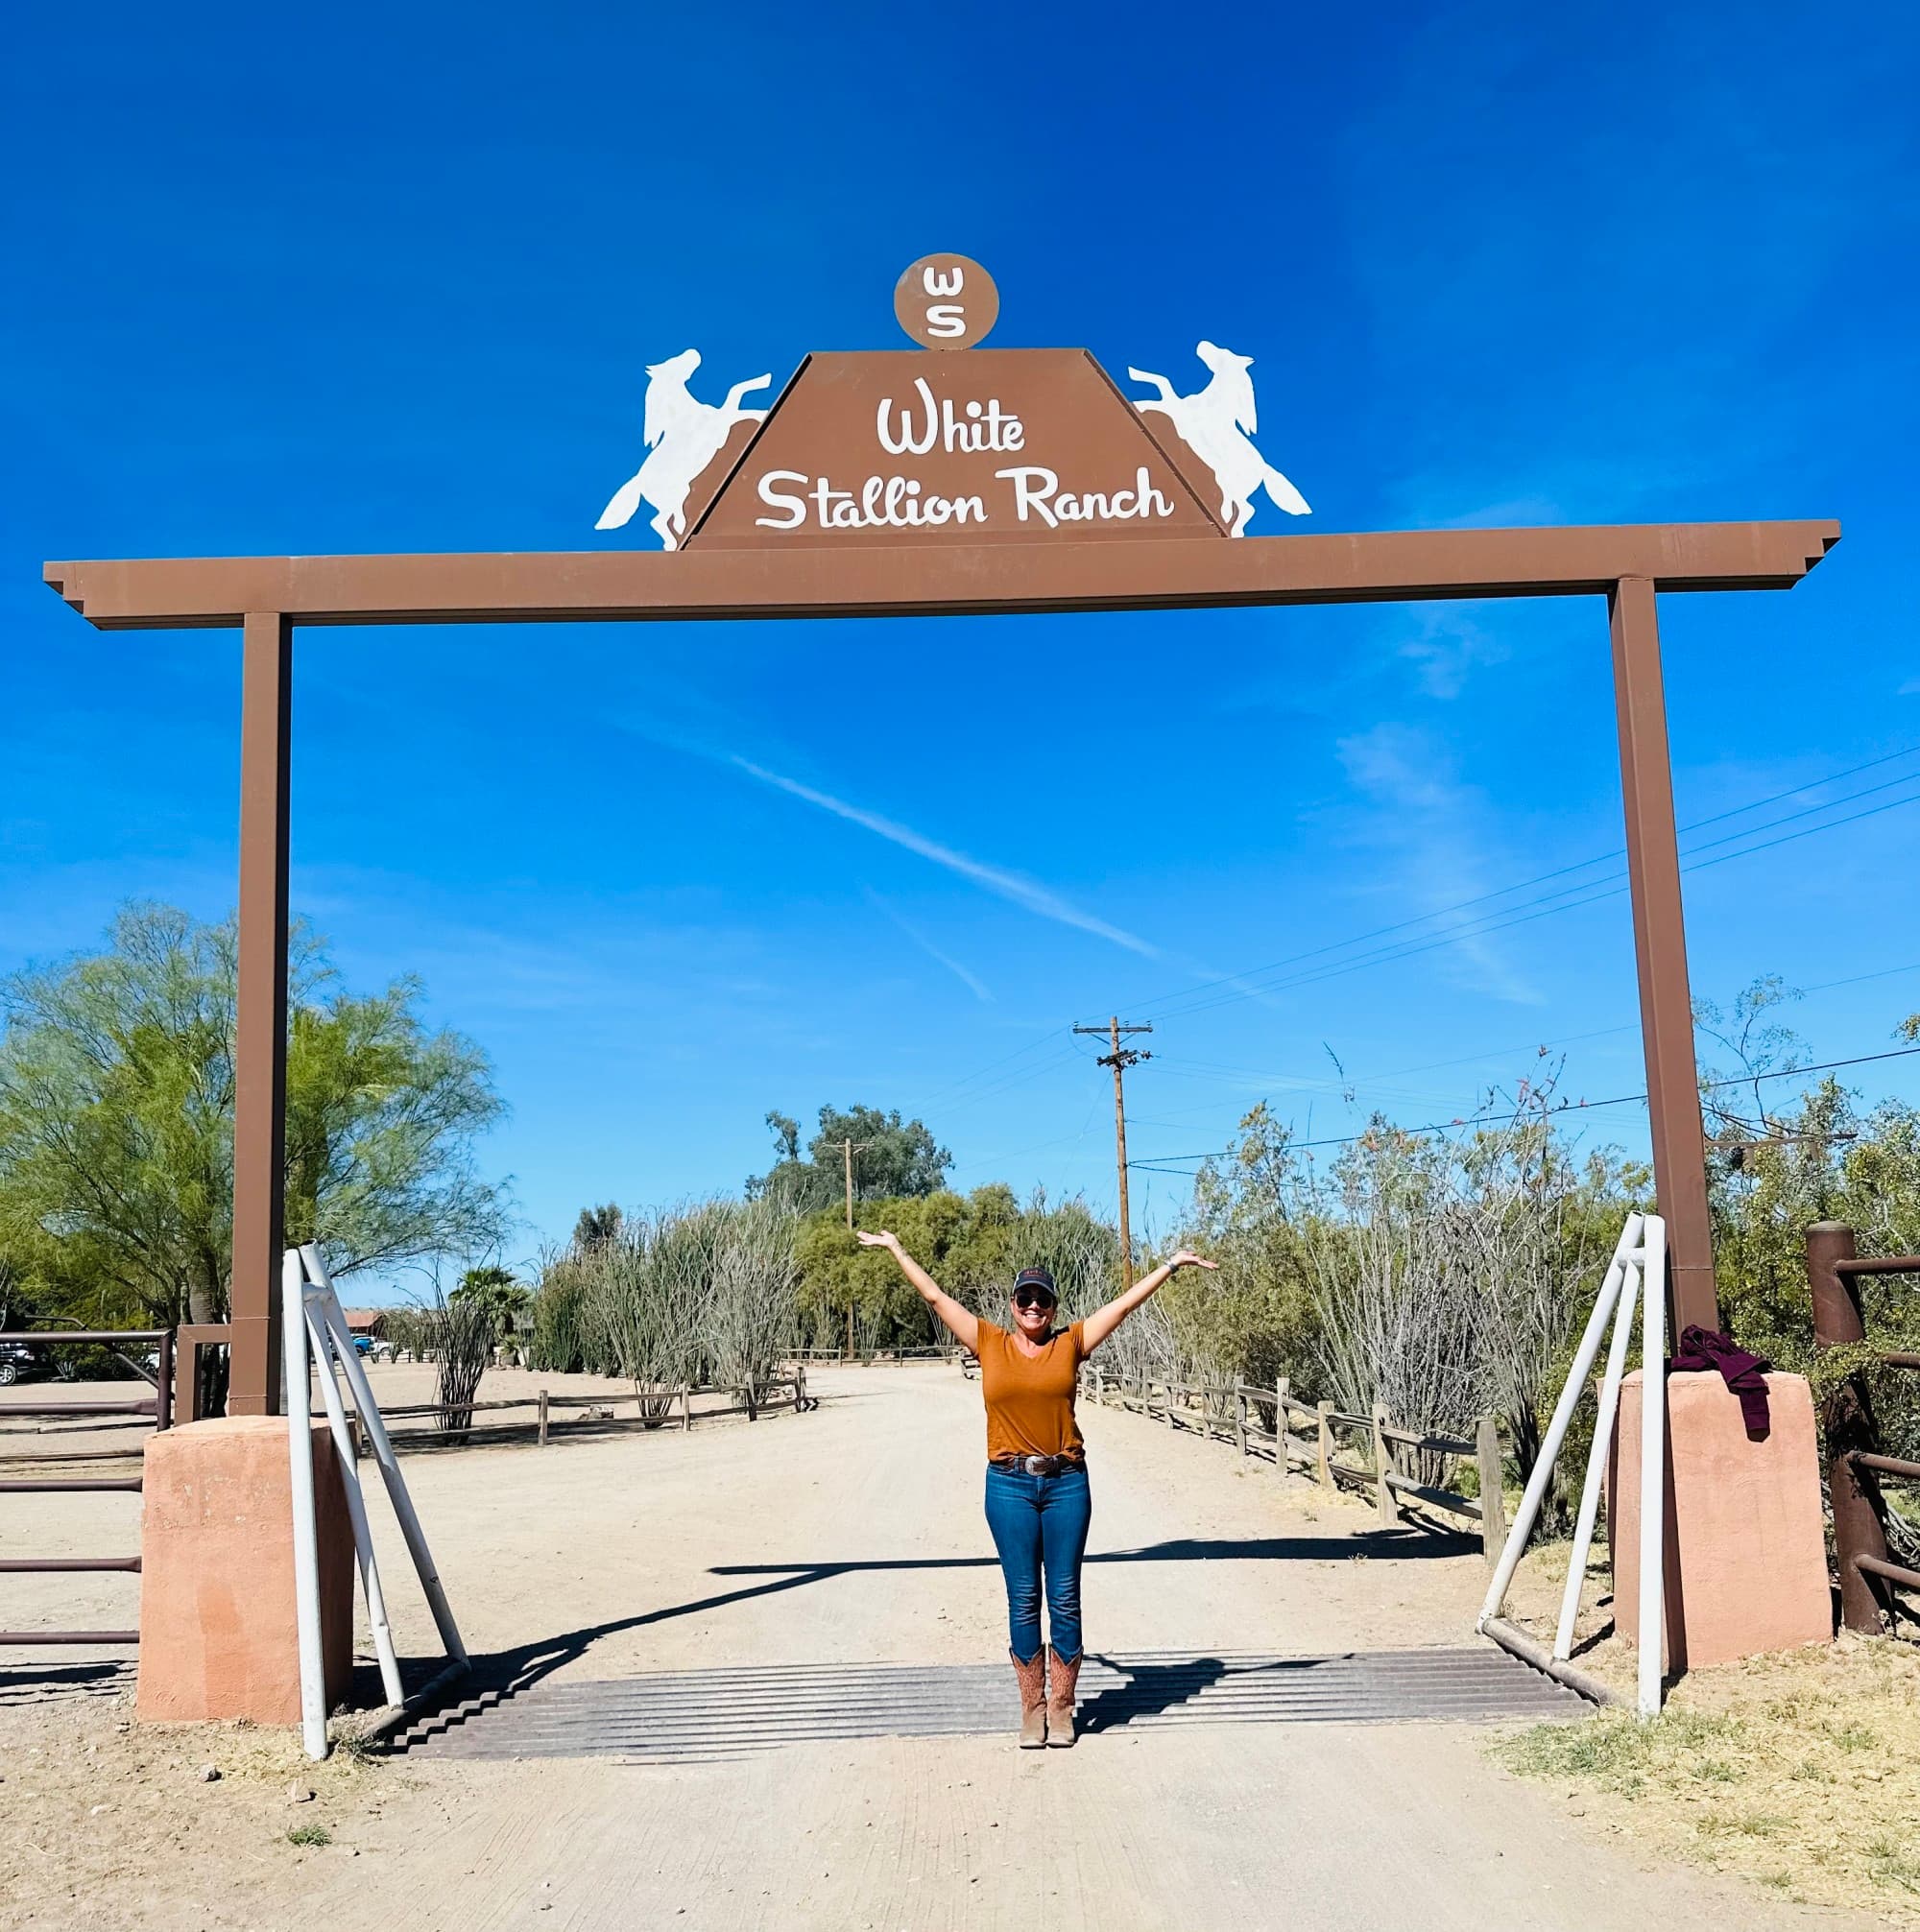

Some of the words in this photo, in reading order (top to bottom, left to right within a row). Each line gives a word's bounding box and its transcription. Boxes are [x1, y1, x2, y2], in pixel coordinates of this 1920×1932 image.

[925, 304, 967, 338] S
[876, 377, 1025, 455] White
[756, 469, 989, 529] Stallion
[995, 466, 1175, 529] Ranch
